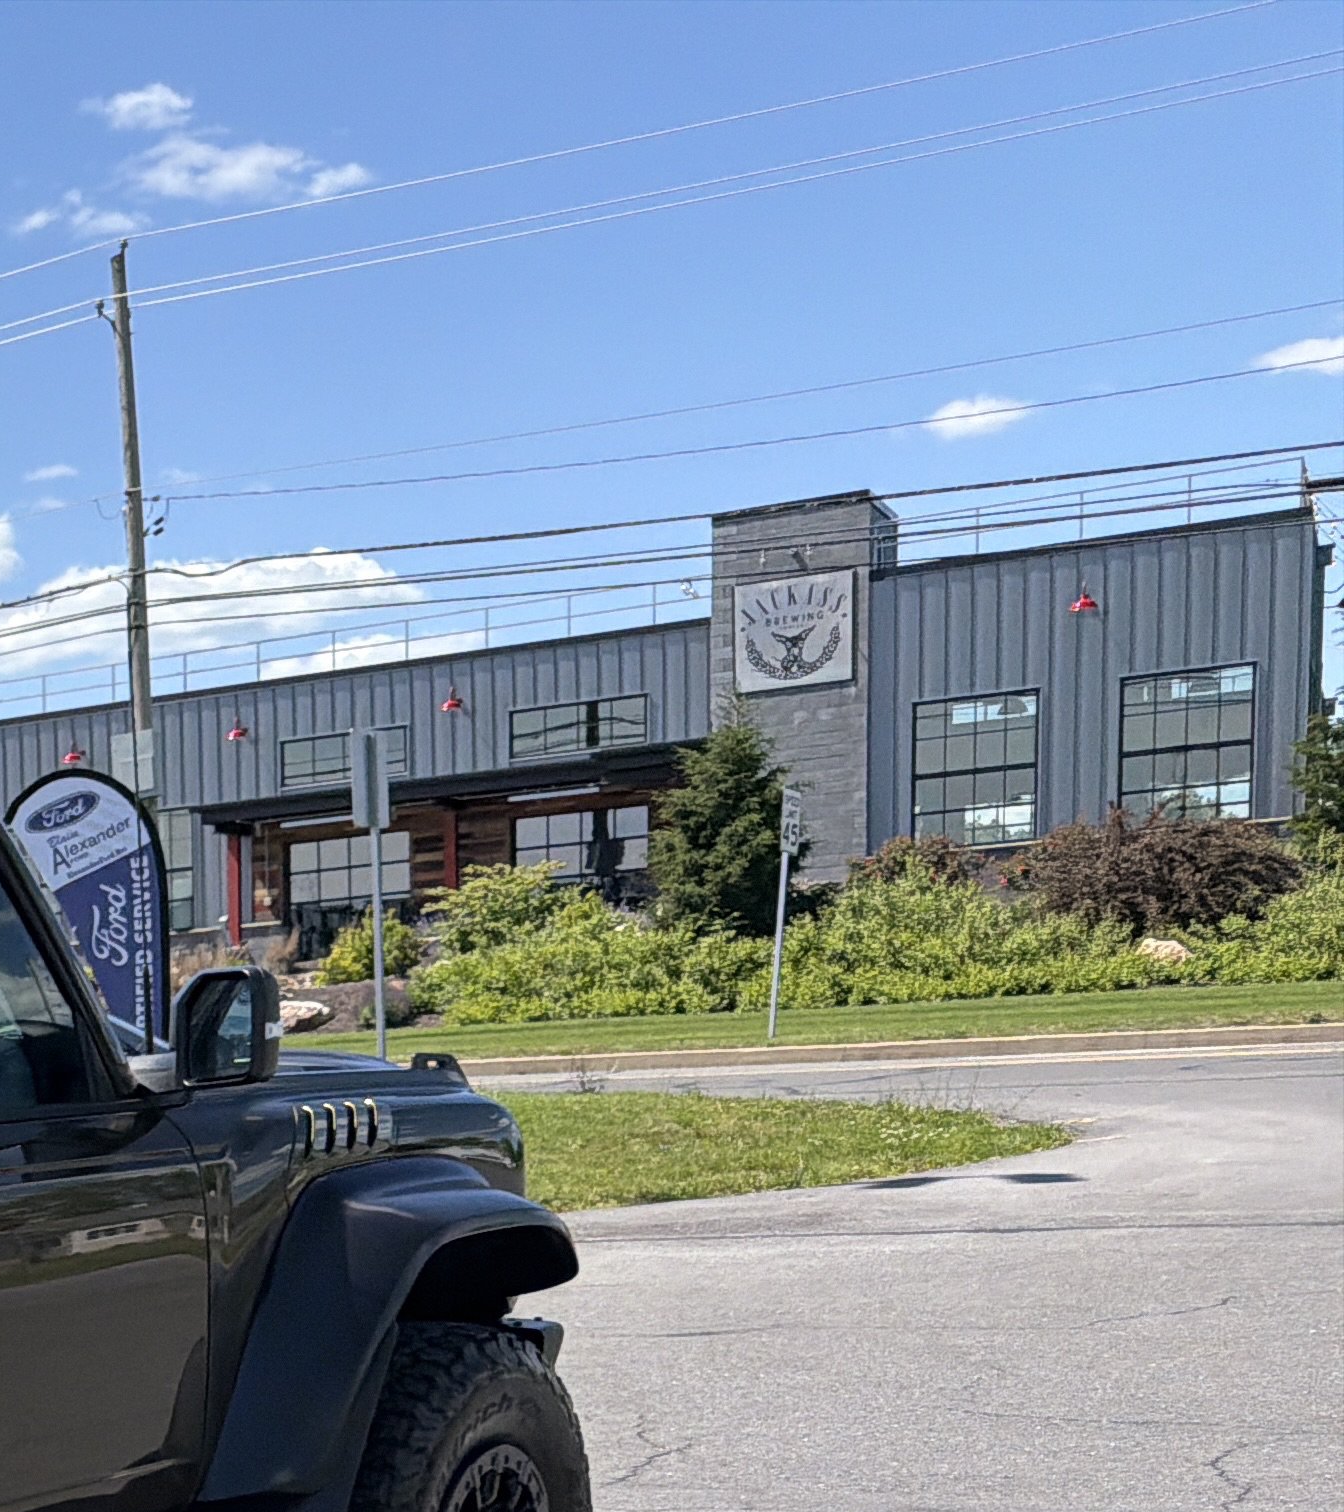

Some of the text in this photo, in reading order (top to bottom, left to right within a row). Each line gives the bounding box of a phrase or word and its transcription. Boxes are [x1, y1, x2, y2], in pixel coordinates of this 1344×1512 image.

[765, 610, 824, 627] BREWING
[41, 799, 85, 828] Ford
[783, 822, 798, 847] 45
[53, 817, 131, 875] Alexander
[129, 854, 152, 942] SERVICE
[91, 883, 128, 967] Ford
